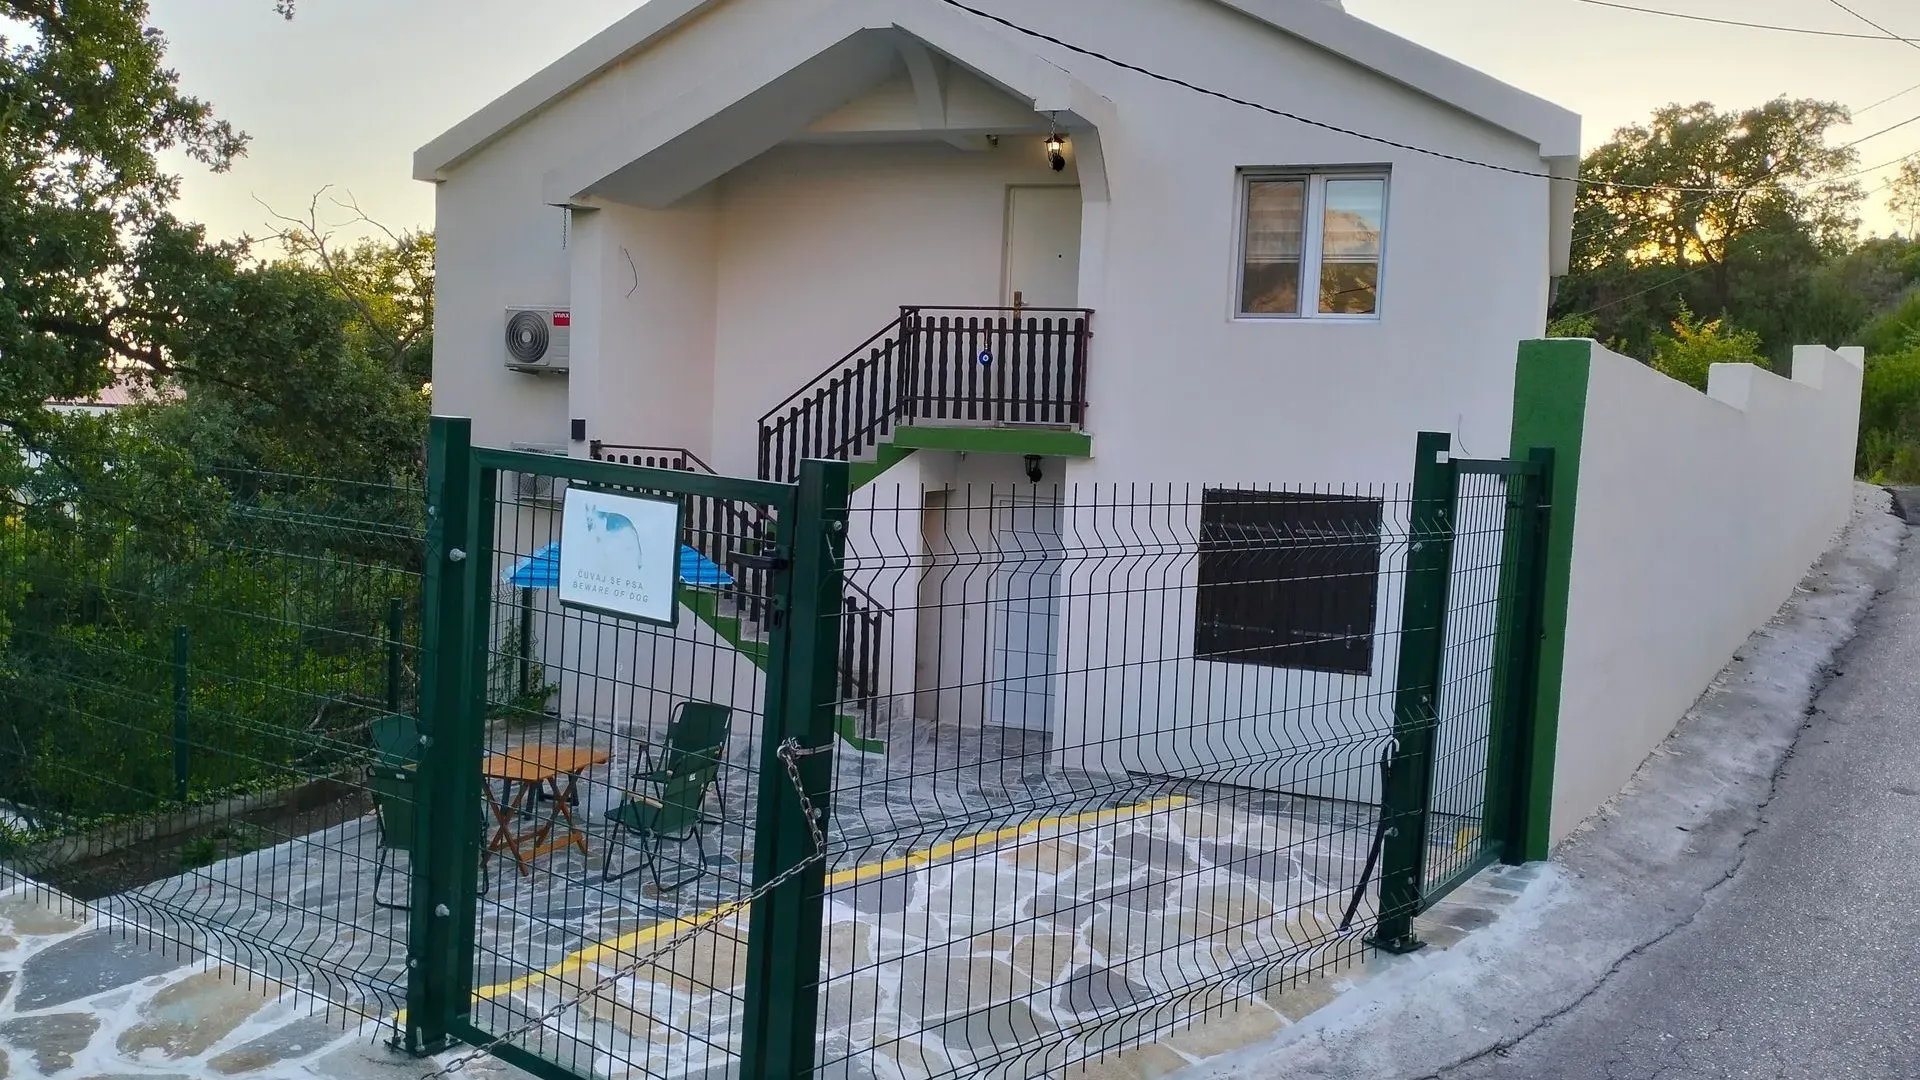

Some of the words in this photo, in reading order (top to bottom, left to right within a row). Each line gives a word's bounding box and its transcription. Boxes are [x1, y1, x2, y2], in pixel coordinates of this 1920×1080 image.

[610, 576, 621, 586] SE
[626, 580, 643, 589] PSA
[573, 581, 609, 595] BEWARE
[614, 589, 625, 597] OF
[630, 592, 648, 602] DOG
